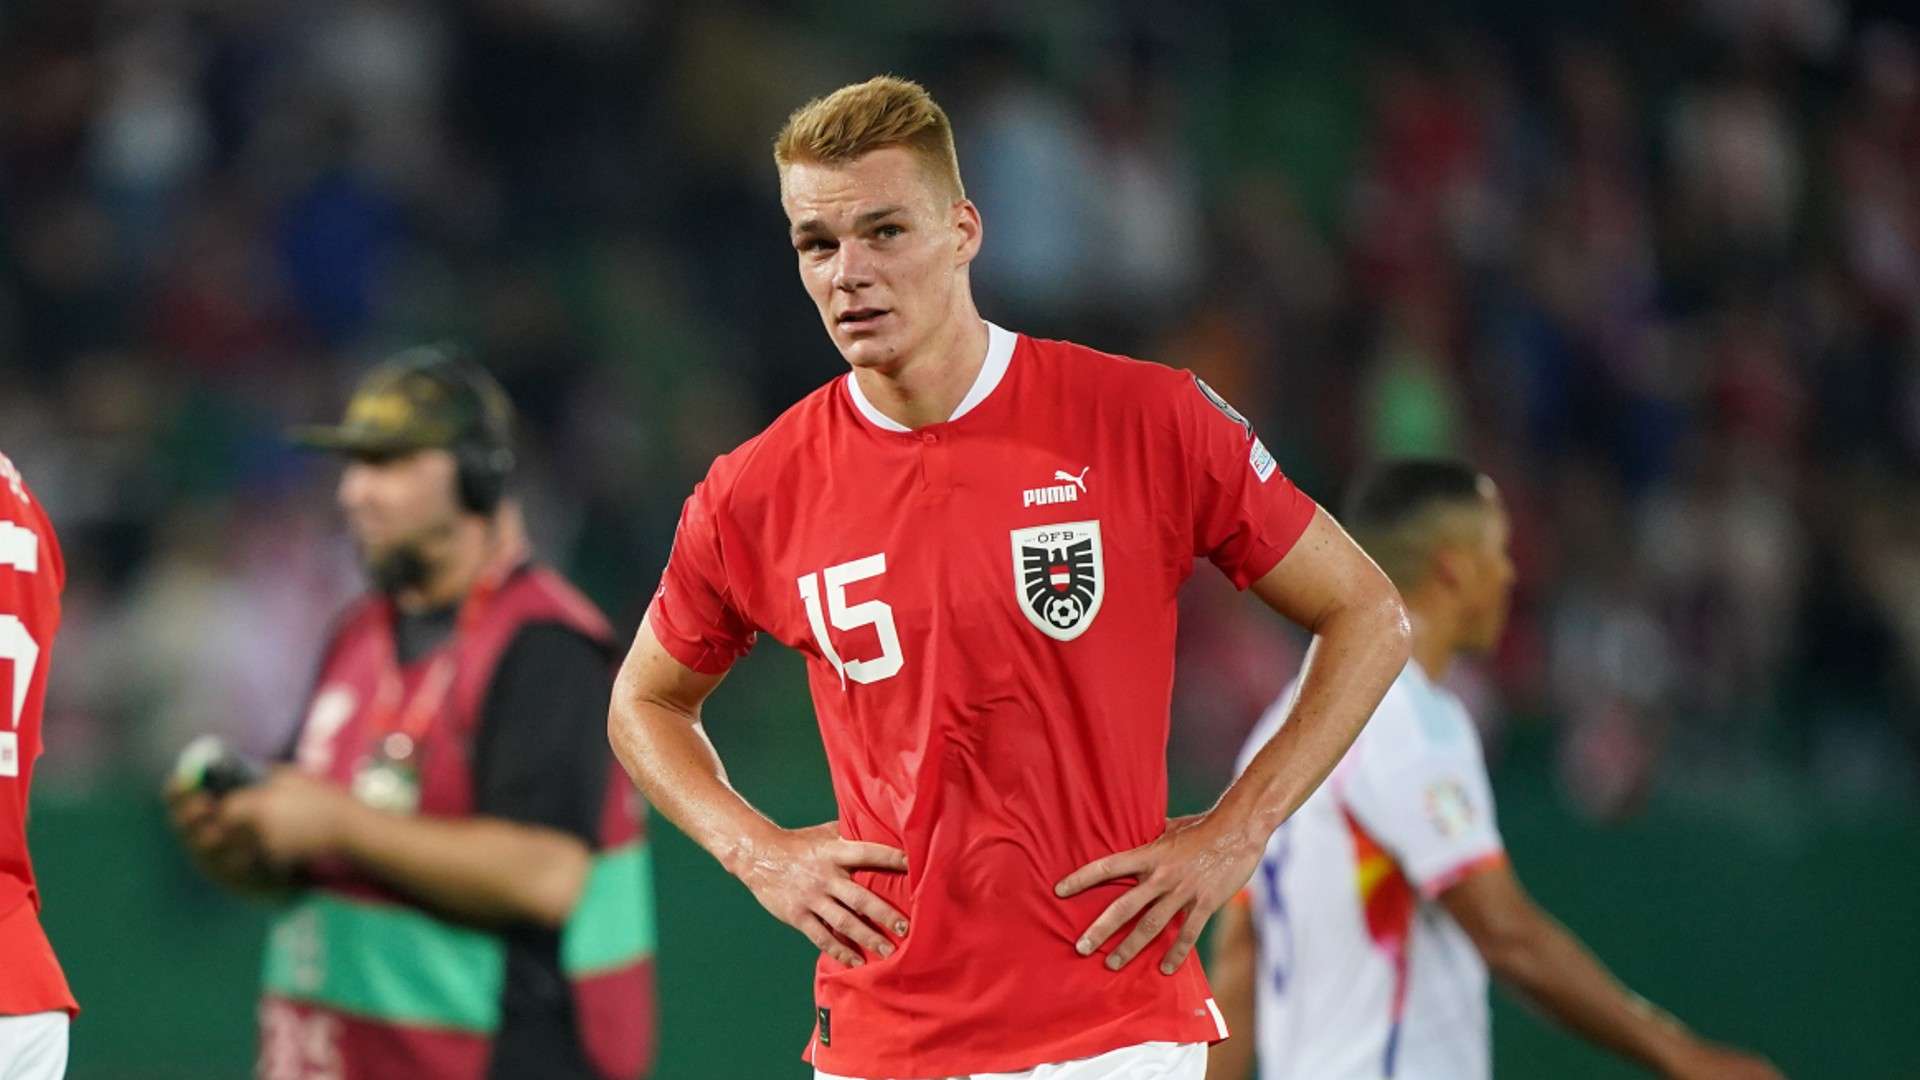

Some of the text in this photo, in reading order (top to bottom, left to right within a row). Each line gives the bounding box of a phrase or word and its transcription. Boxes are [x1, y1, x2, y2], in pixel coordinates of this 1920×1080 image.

[1024, 484, 1078, 507] PUMA
[1037, 531, 1075, 543] ÖFB
[797, 552, 904, 691] 15
